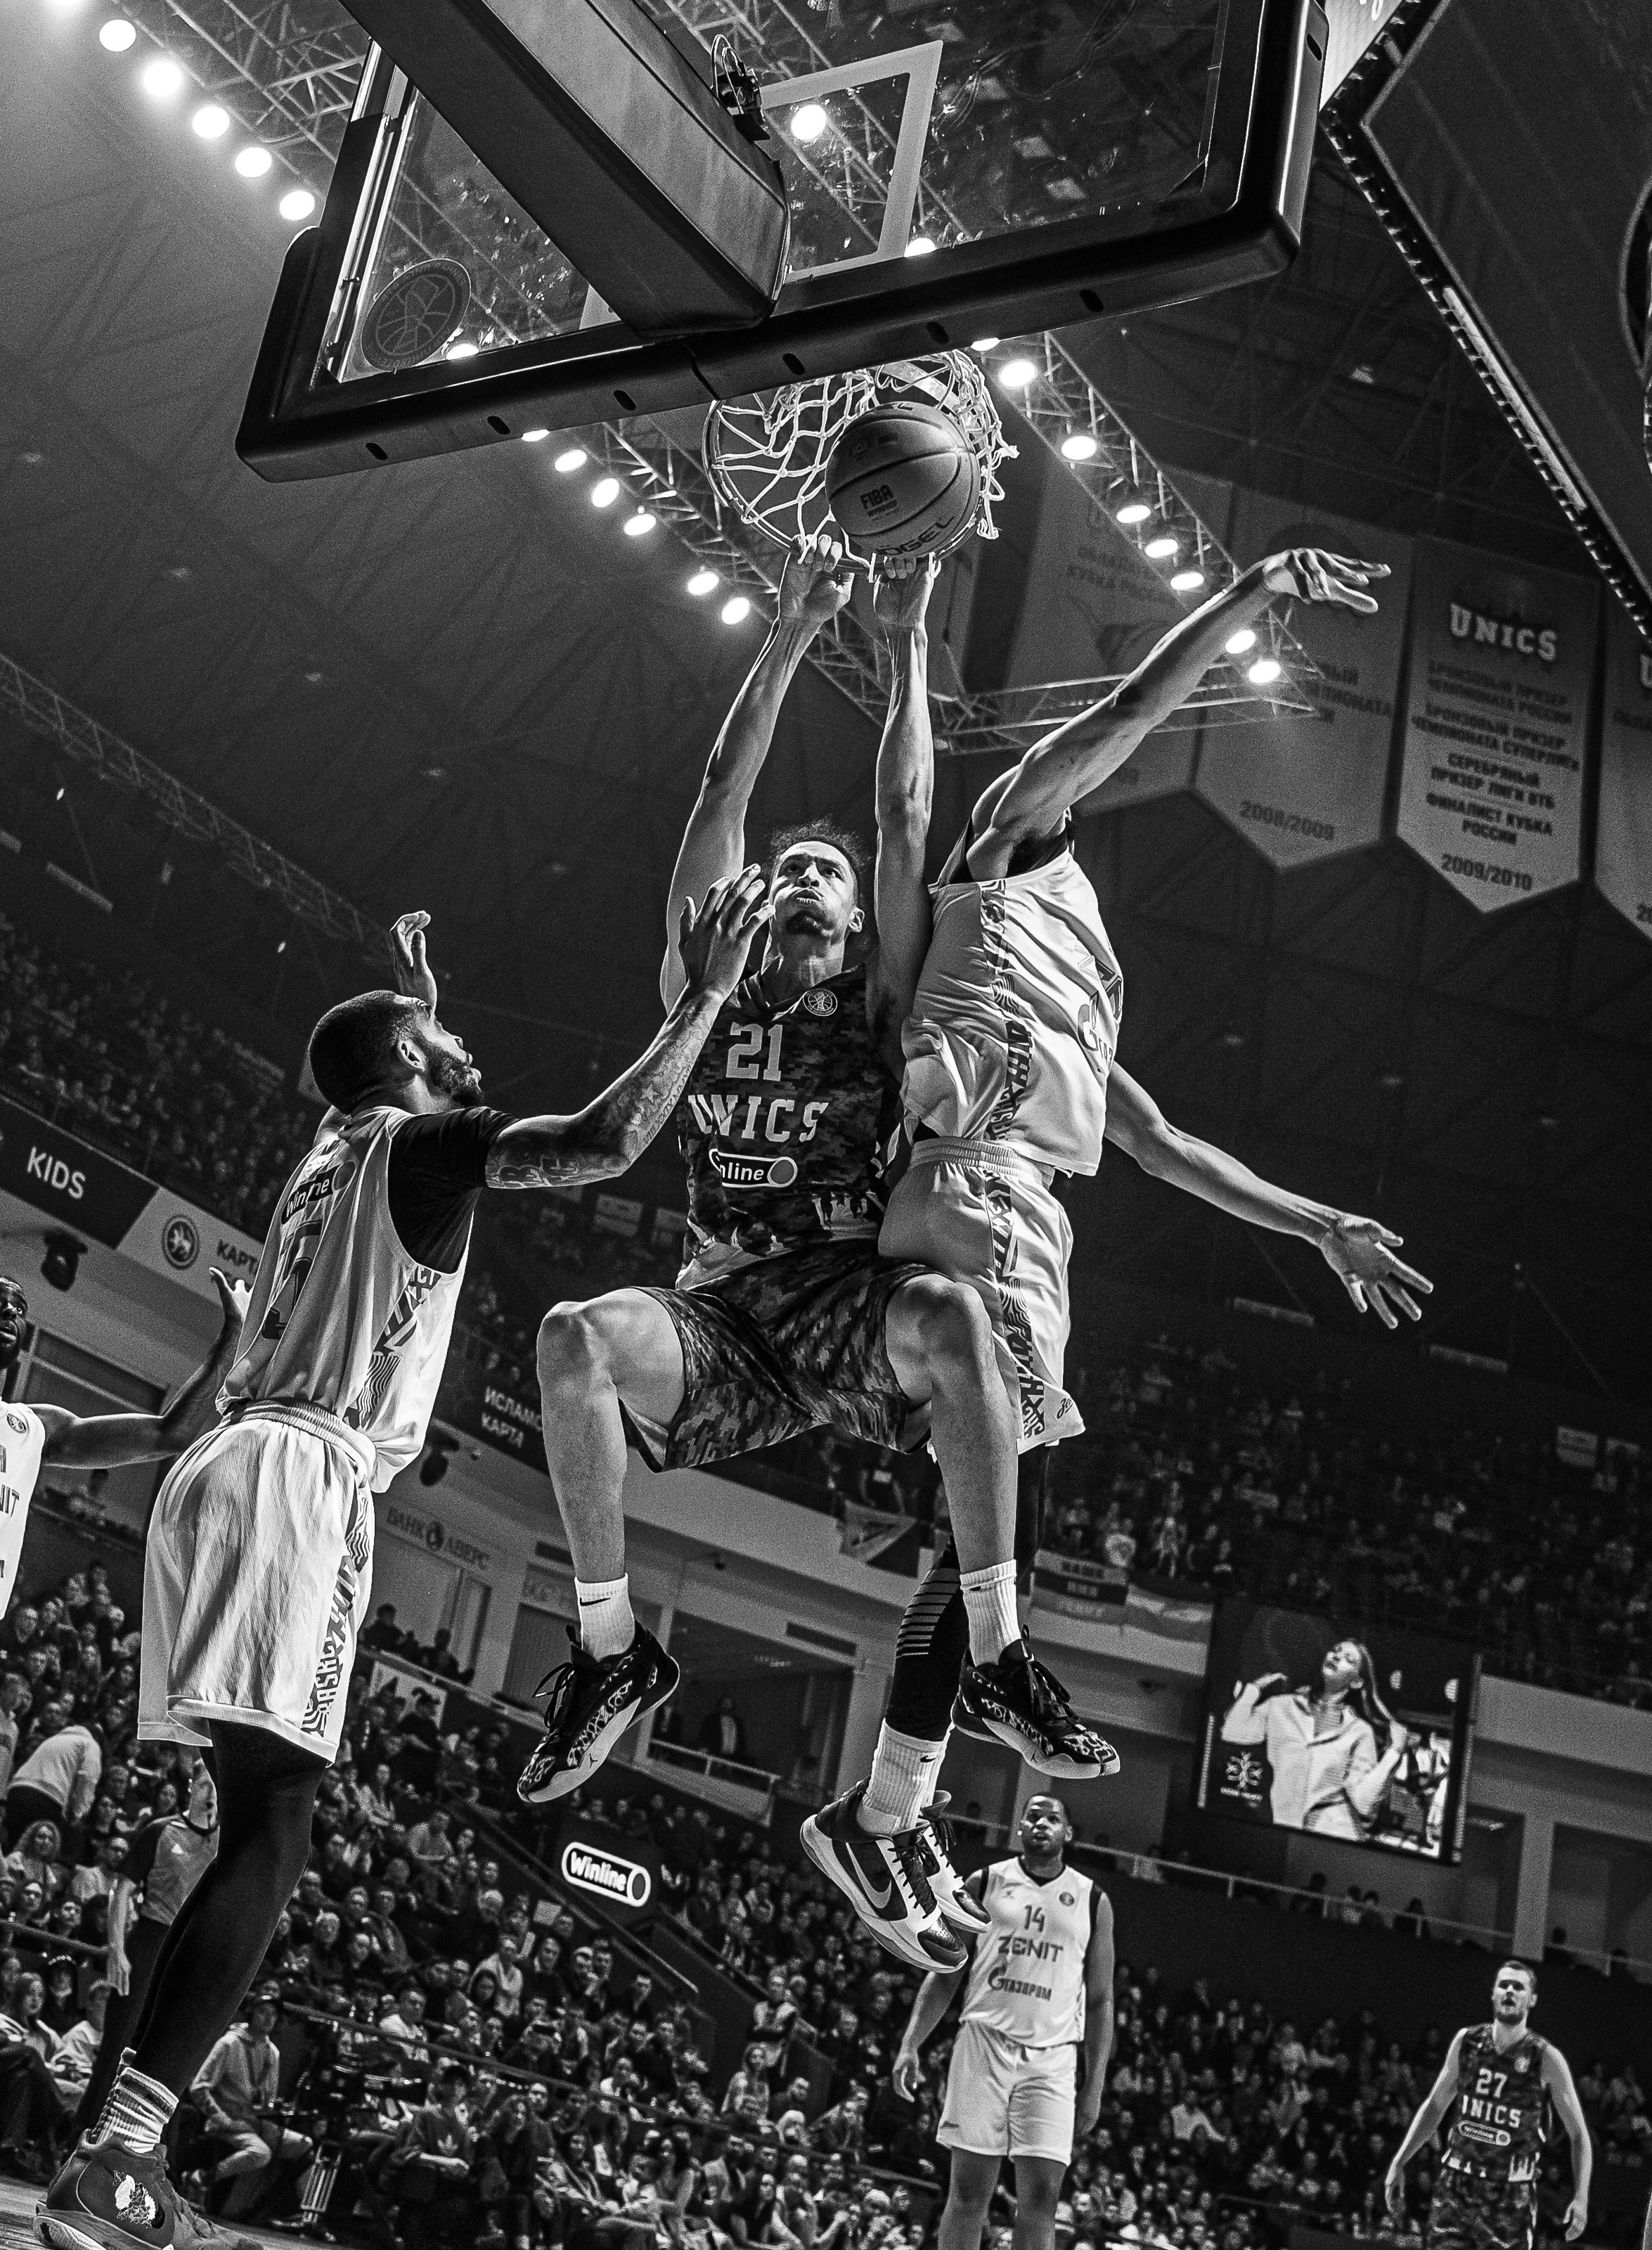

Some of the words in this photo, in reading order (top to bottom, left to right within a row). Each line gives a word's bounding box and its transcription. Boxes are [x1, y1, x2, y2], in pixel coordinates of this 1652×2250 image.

[860, 484, 894, 511] FIBA
[1450, 602, 1557, 662] UNICS
[1442, 853, 1533, 891] 2009/2010
[725, 1022, 783, 1081] 21
[26, 1145, 86, 1199] KIDS
[286, 1178, 330, 1218] winne
[571, 1851, 627, 1891] Winline
[1024, 1904, 1045, 1932] 14
[998, 1934, 1064, 1962] ZENIT
[1476, 2067, 1508, 2099] 27
